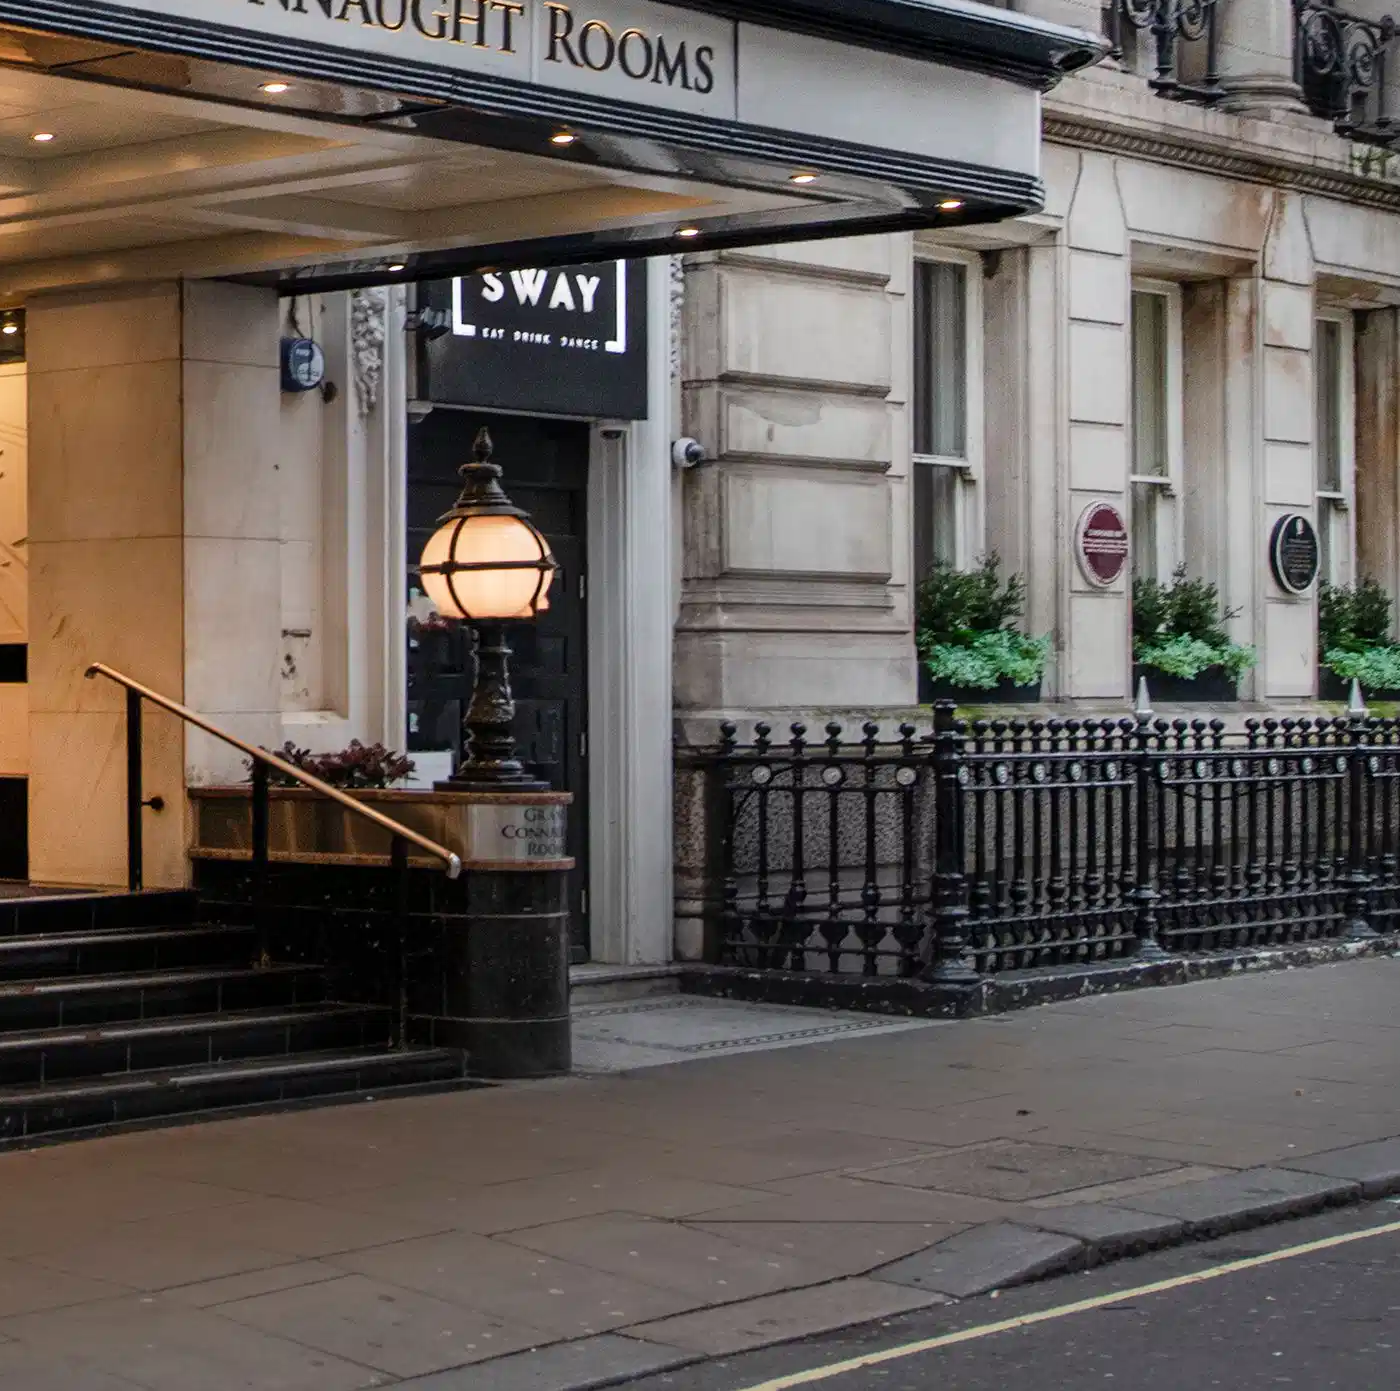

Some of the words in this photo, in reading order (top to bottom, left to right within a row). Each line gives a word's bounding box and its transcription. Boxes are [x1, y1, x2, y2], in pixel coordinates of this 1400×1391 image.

[543, 1, 715, 95] ROOMS
[481, 268, 601, 313] SWAY
[482, 327, 506, 340] EAT
[513, 330, 552, 345] DRINK
[527, 841, 565, 855] ROO
